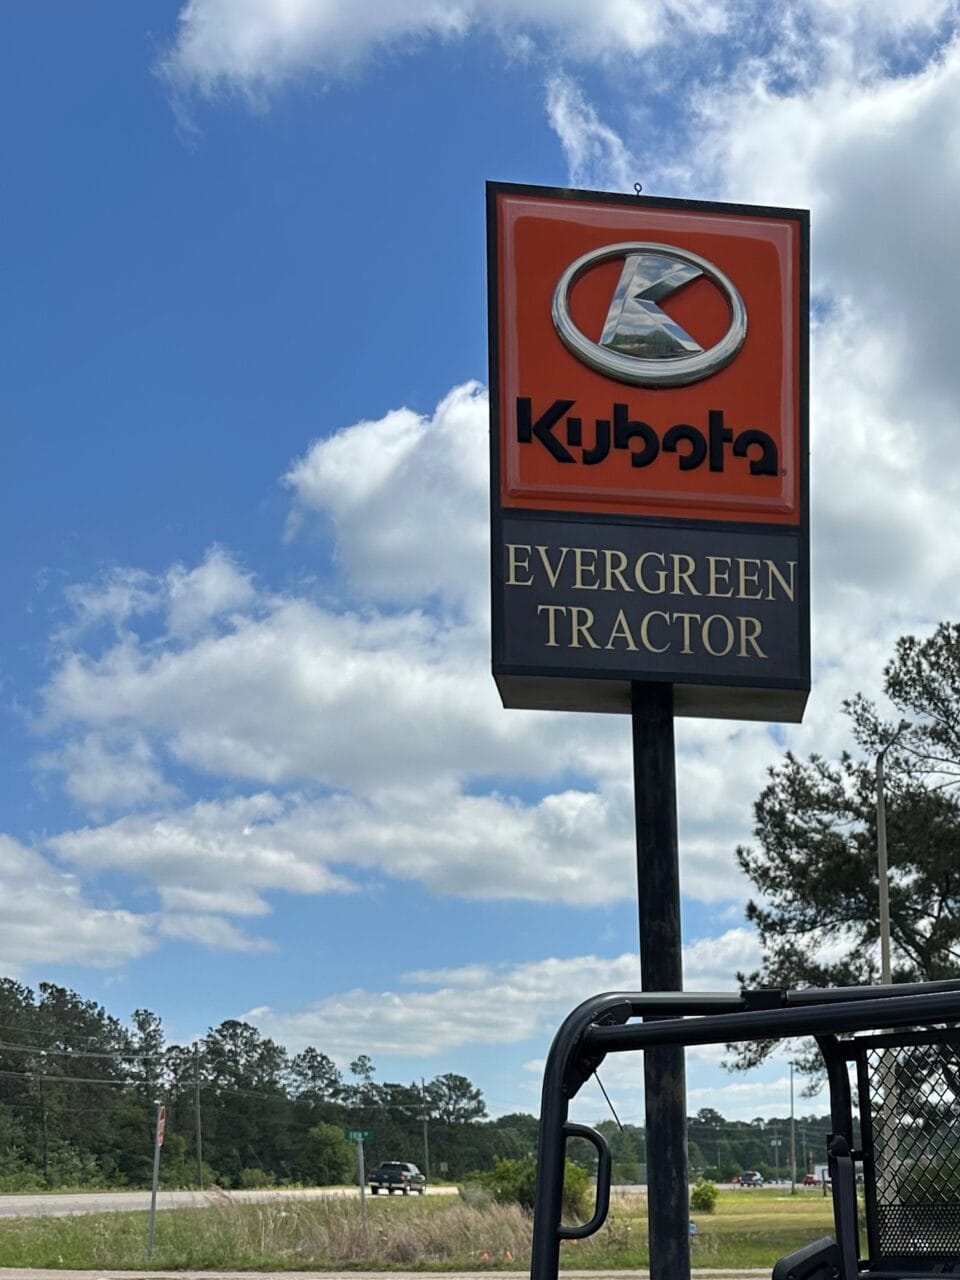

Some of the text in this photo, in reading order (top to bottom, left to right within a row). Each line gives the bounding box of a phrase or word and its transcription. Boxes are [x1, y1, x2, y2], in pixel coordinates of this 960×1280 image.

[516, 397, 778, 476] Kubota
[505, 544, 798, 602] EVERGREEN
[537, 604, 768, 658] TRACTOR
